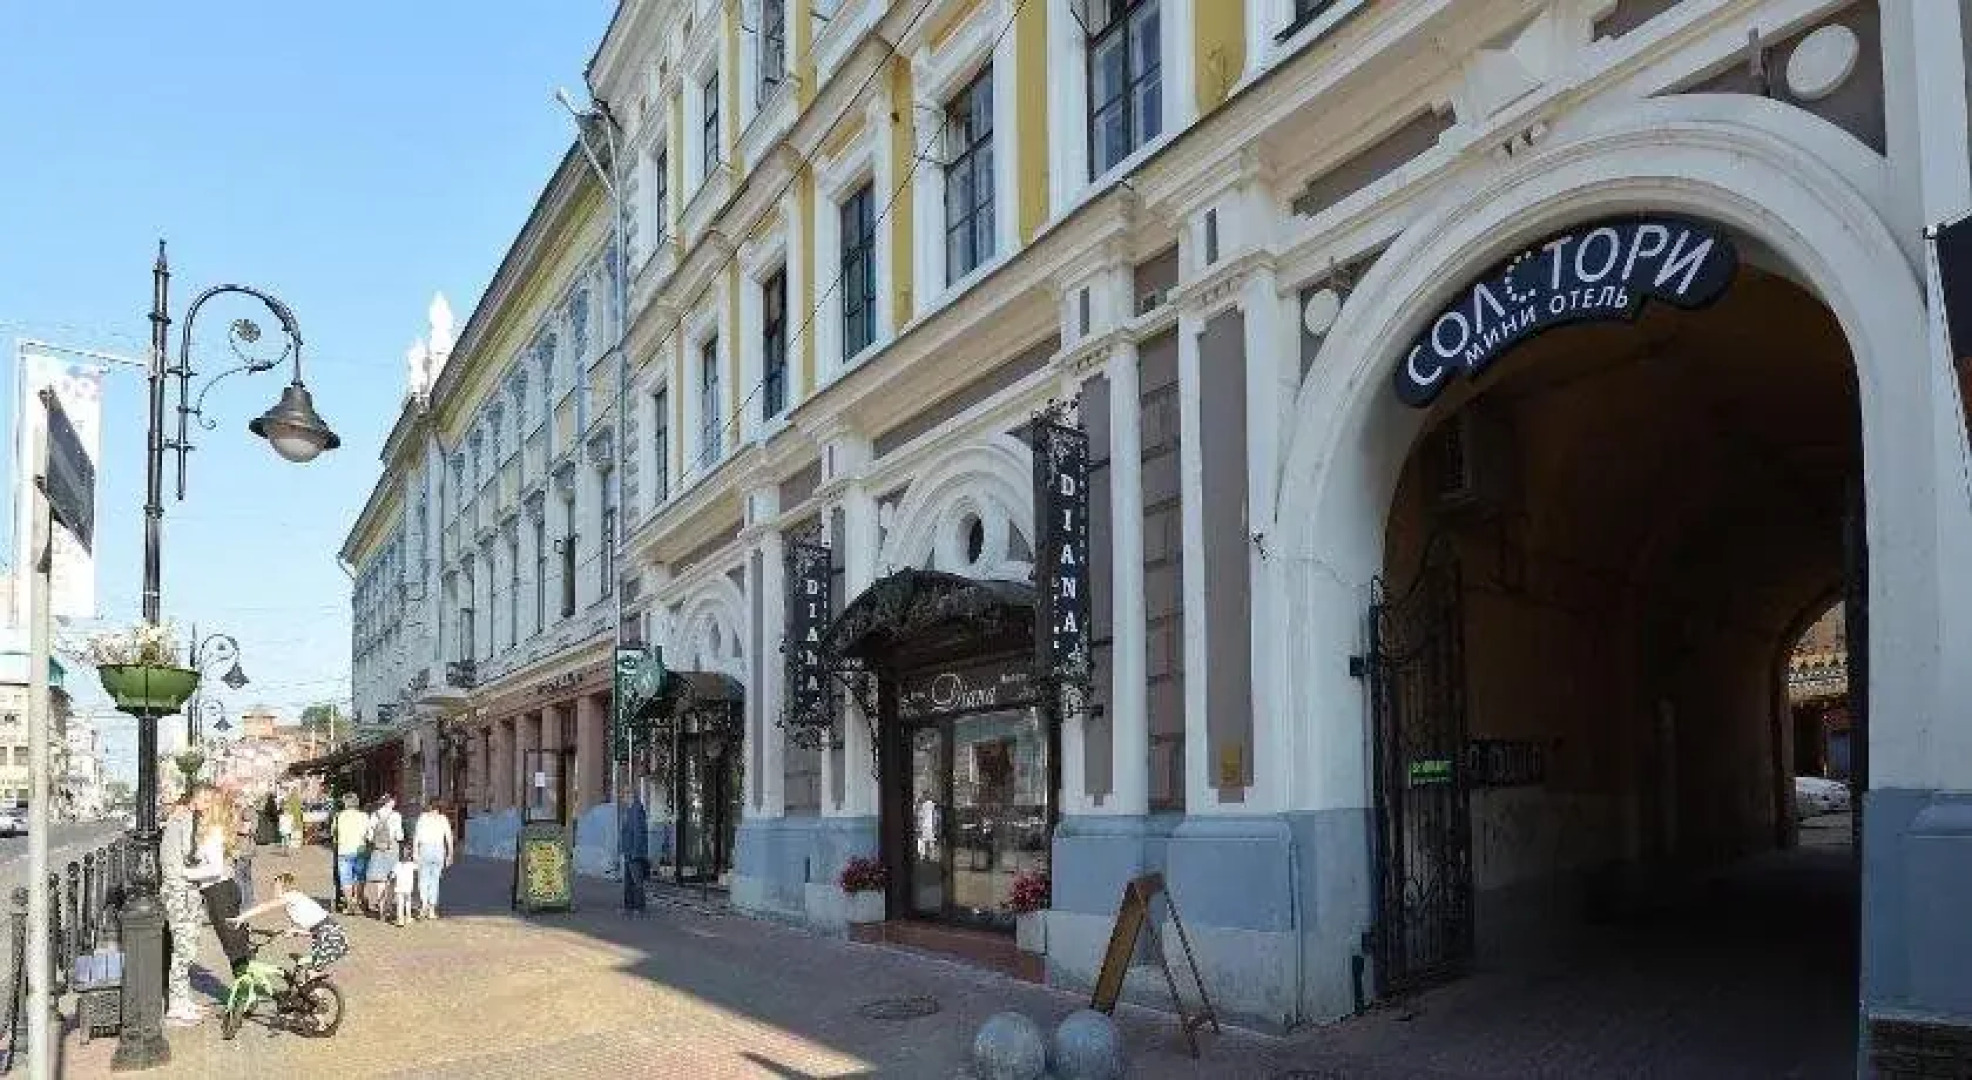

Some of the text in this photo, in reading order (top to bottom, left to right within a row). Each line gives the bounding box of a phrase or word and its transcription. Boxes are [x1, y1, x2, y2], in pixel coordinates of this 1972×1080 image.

[1407, 223, 1715, 386] СОЛСТОРИ
[1464, 285, 1629, 366] МИНИ ОТЕЛЬ
[1060, 473, 1079, 633] DIANA
[805, 578, 819, 691] DIANA
